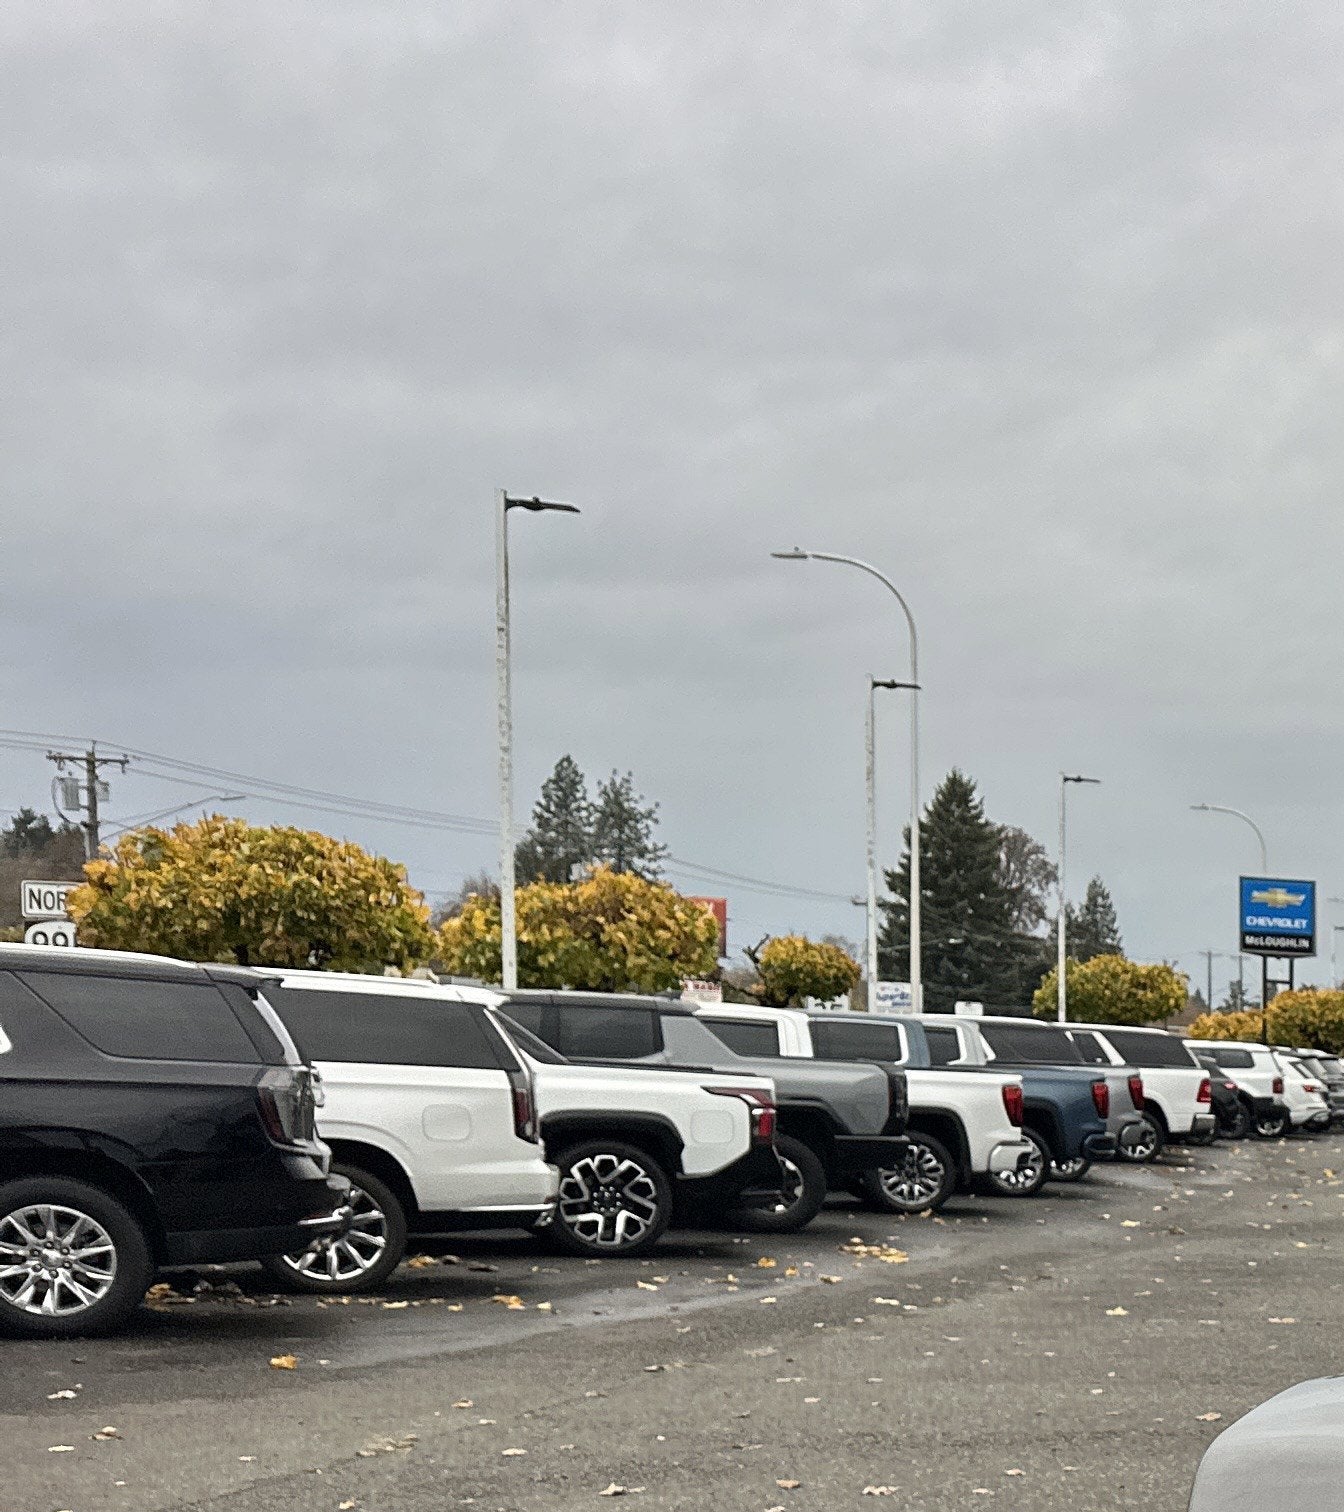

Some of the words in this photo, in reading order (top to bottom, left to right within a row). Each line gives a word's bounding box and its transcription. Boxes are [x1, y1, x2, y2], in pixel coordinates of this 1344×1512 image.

[28, 888, 66, 911] NOR
[1245, 915, 1309, 929] CHEVROLET
[1244, 934, 1310, 949] McLOUGHLIN
